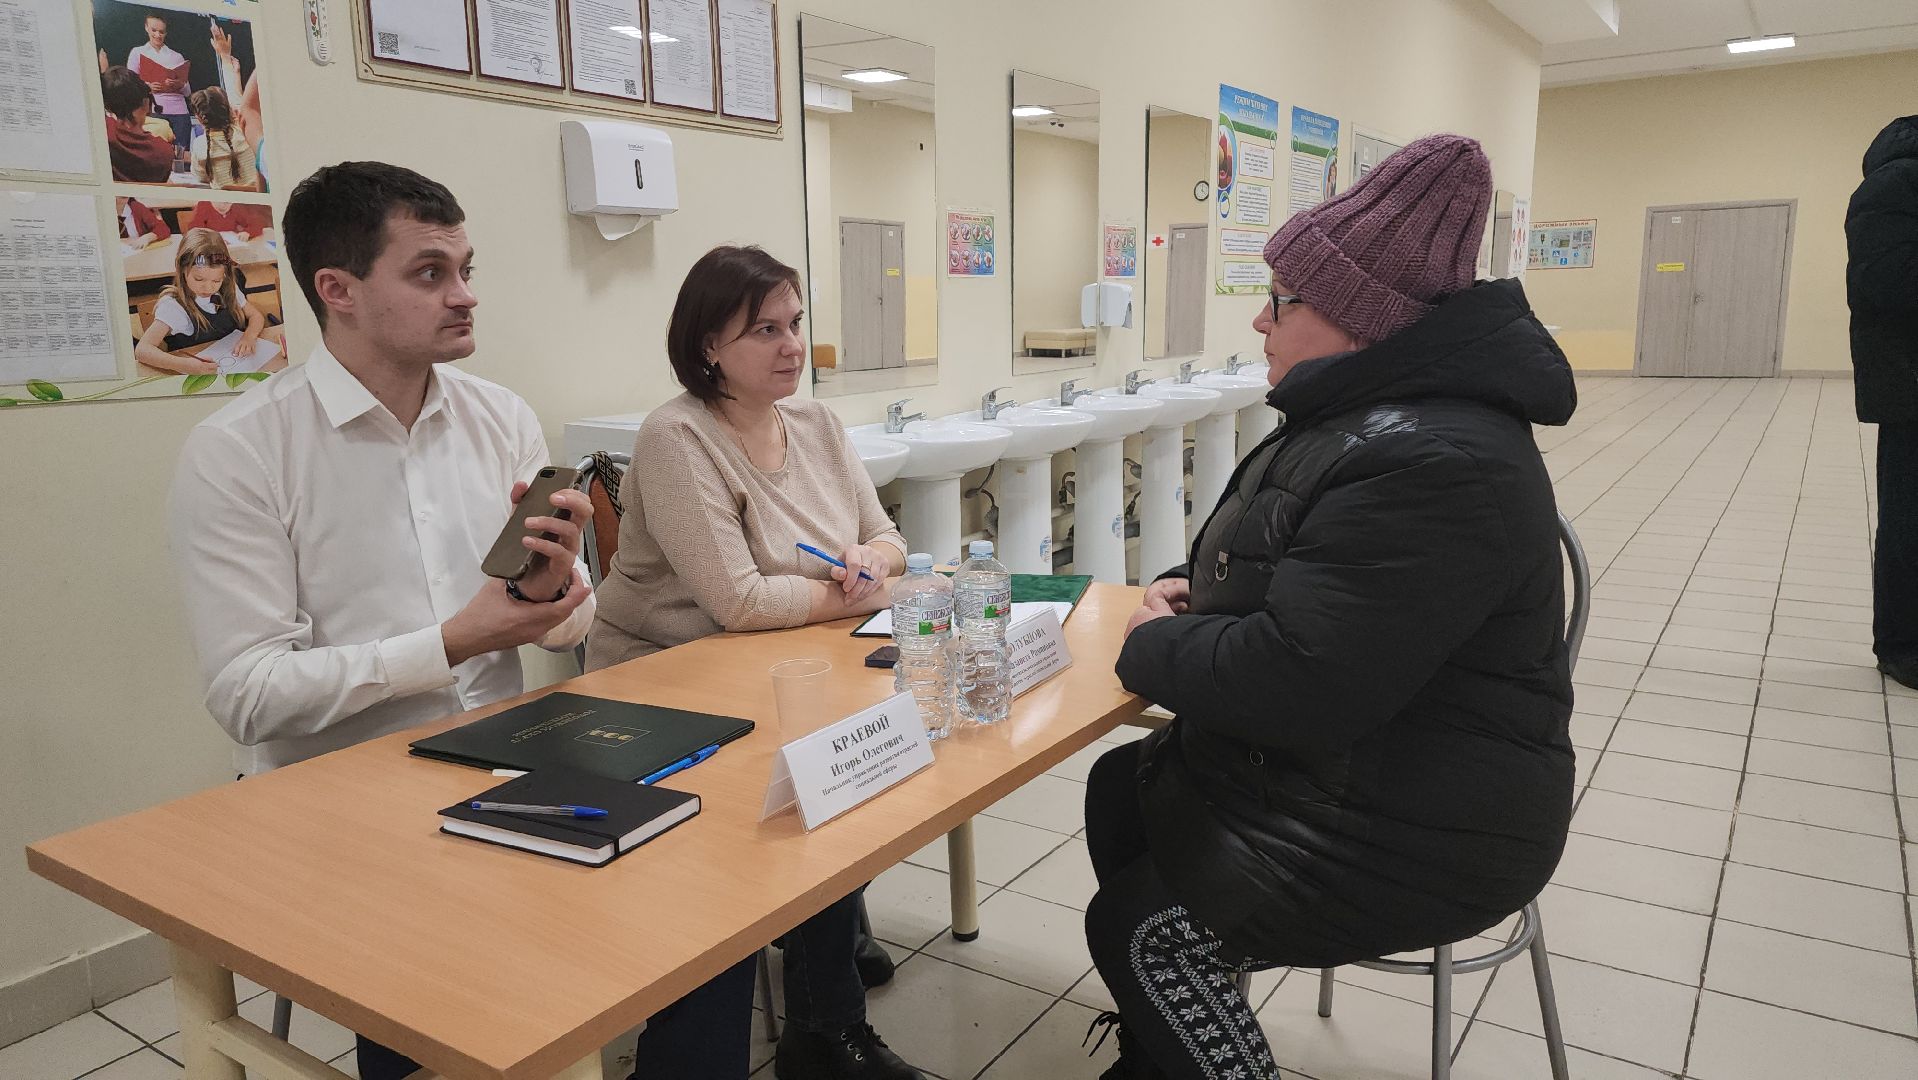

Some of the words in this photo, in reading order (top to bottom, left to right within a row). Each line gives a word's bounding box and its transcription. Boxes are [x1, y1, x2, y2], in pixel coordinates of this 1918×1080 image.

[830, 756, 862, 777] Игорь
[862, 733, 905, 761] Олегович
[831, 713, 890, 755] КРАЕВОЙ
